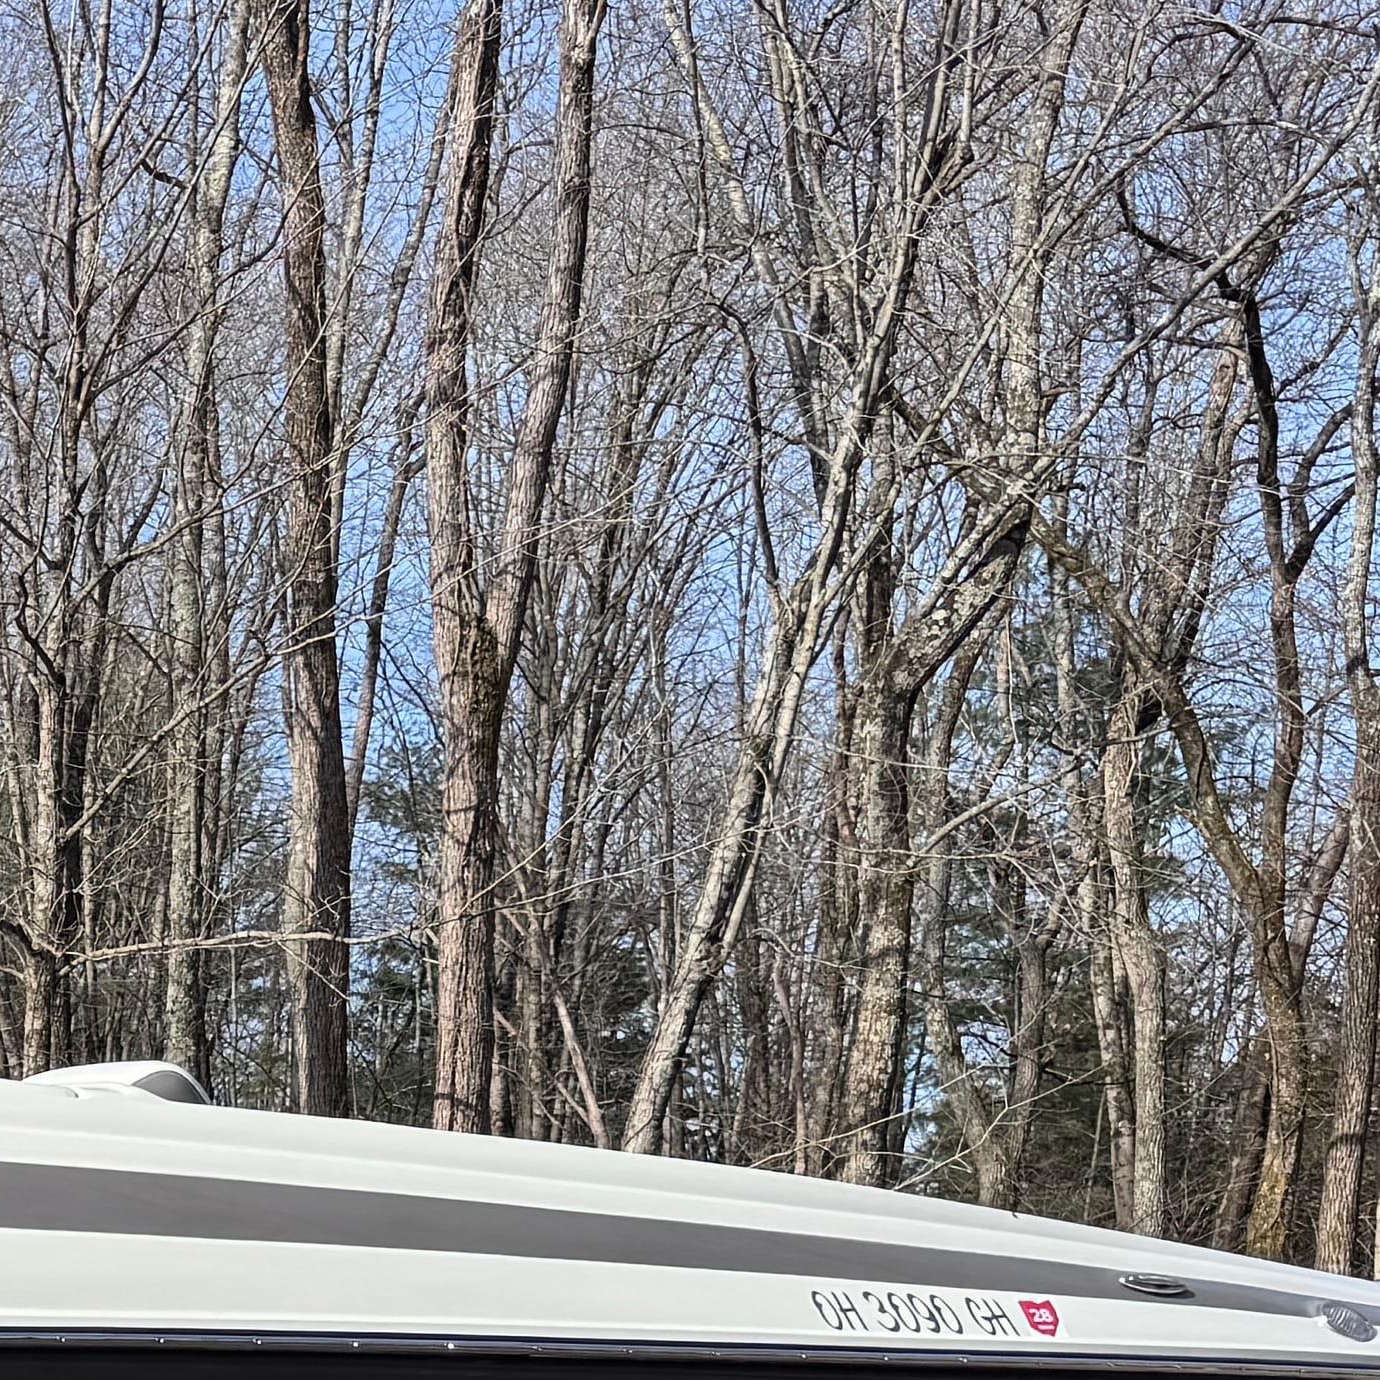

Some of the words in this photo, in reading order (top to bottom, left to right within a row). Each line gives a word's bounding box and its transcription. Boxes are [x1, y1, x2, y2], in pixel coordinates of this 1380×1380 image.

[811, 1290, 869, 1331] OH
[862, 1291, 963, 1334] 3090
[964, 1297, 1020, 1336] GH
[1028, 1308, 1053, 1323] 28
